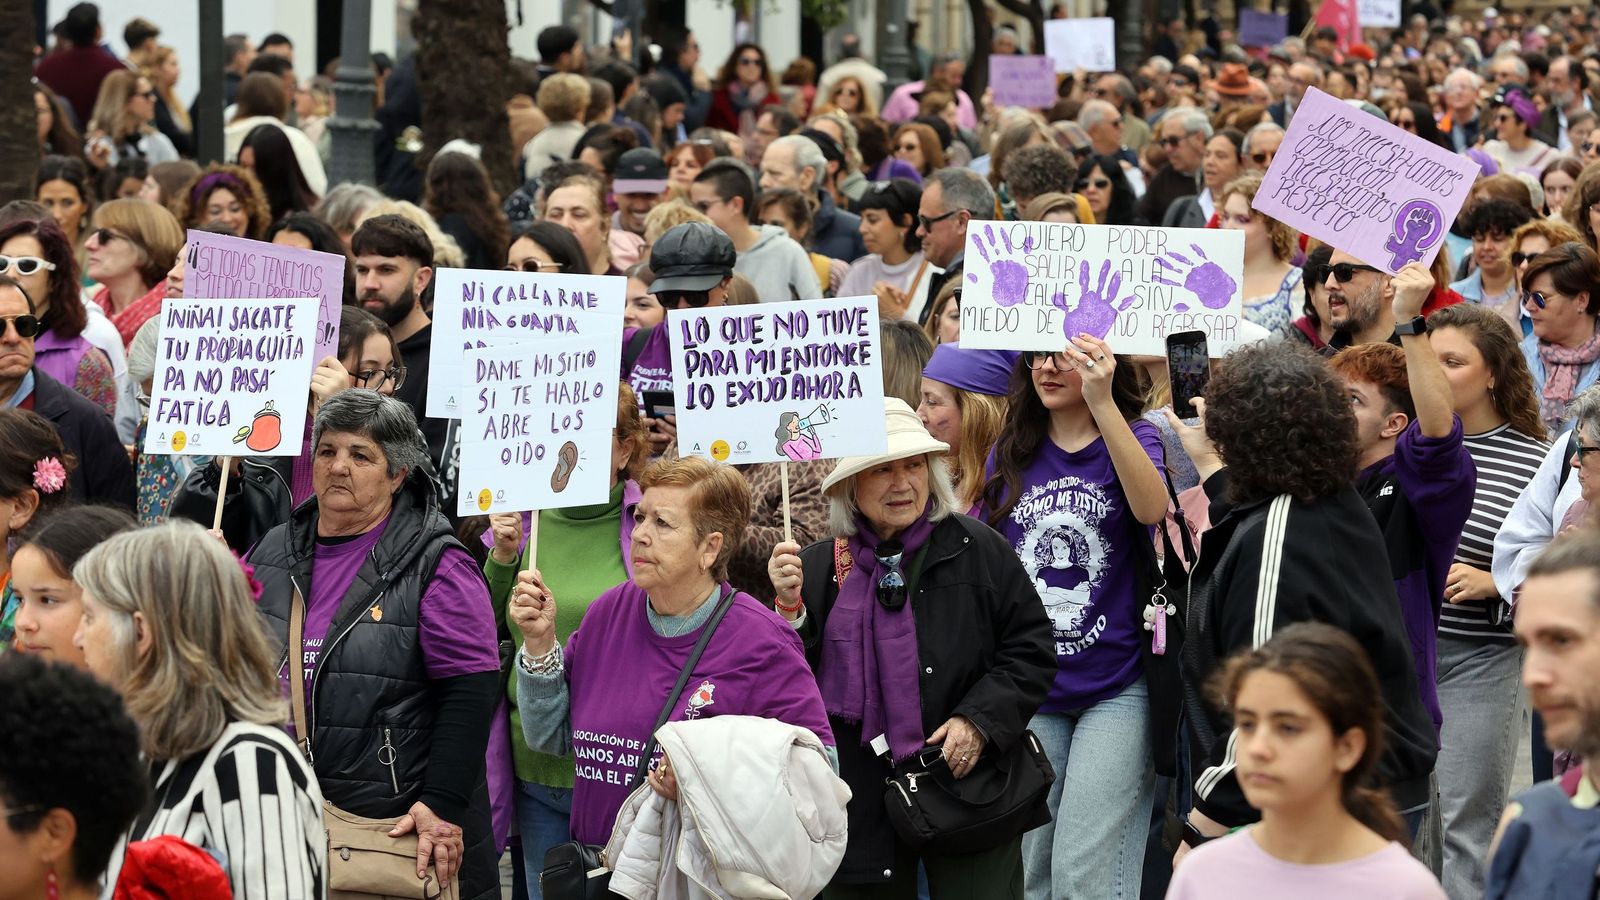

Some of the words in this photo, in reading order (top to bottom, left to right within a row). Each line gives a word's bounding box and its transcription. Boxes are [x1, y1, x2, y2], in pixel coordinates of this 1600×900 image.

[1271, 176, 1361, 232] RESPETO
[1010, 223, 1086, 253] QUIERO
[1107, 228, 1168, 256] PODER
[217, 248, 256, 281] TODAS
[262, 255, 323, 293] TENEMOS
[1024, 254, 1076, 279] SALIR
[1121, 258, 1133, 282] A
[1142, 256, 1163, 283] LA
[462, 281, 485, 303] NI
[492, 283, 600, 310] CALLARME
[1023, 282, 1074, 307] CALLE
[1131, 285, 1173, 311] SIN
[681, 316, 711, 350] LO
[719, 314, 764, 345] QUE
[773, 310, 809, 340] NO
[816, 306, 869, 336] TUVE
[963, 306, 1019, 333] MIEDO
[1037, 308, 1057, 334] DE
[1114, 312, 1139, 337] NO
[1152, 313, 1237, 341] REGRESAR
[164, 337, 189, 361] TU
[195, 333, 253, 363] PROPIA
[684, 349, 739, 379] PARA
[780, 340, 871, 375] ENTONCE
[163, 366, 186, 392] PA
[193, 367, 223, 394] NO
[476, 358, 523, 384] DAME
[534, 353, 552, 378] MI
[556, 349, 597, 377] SITIO
[478, 387, 496, 413] SI
[511, 384, 532, 406] TE
[546, 380, 604, 406] HABLO
[686, 382, 715, 410] LO
[726, 377, 787, 407] EXIJO
[791, 371, 863, 400] AHORA
[156, 397, 231, 427] FATIGA
[483, 413, 532, 441] ABRE
[551, 409, 584, 434] LOS
[501, 441, 546, 466] OIDO
[1015, 494, 1054, 525] COMO
[1056, 490, 1073, 507] ME
[1073, 490, 1107, 518] VISTO
[1055, 606, 1080, 614] MARZO
[1055, 614, 1107, 656] ESVISTO
[626, 739, 640, 750] DE
[606, 769, 621, 785] EL
